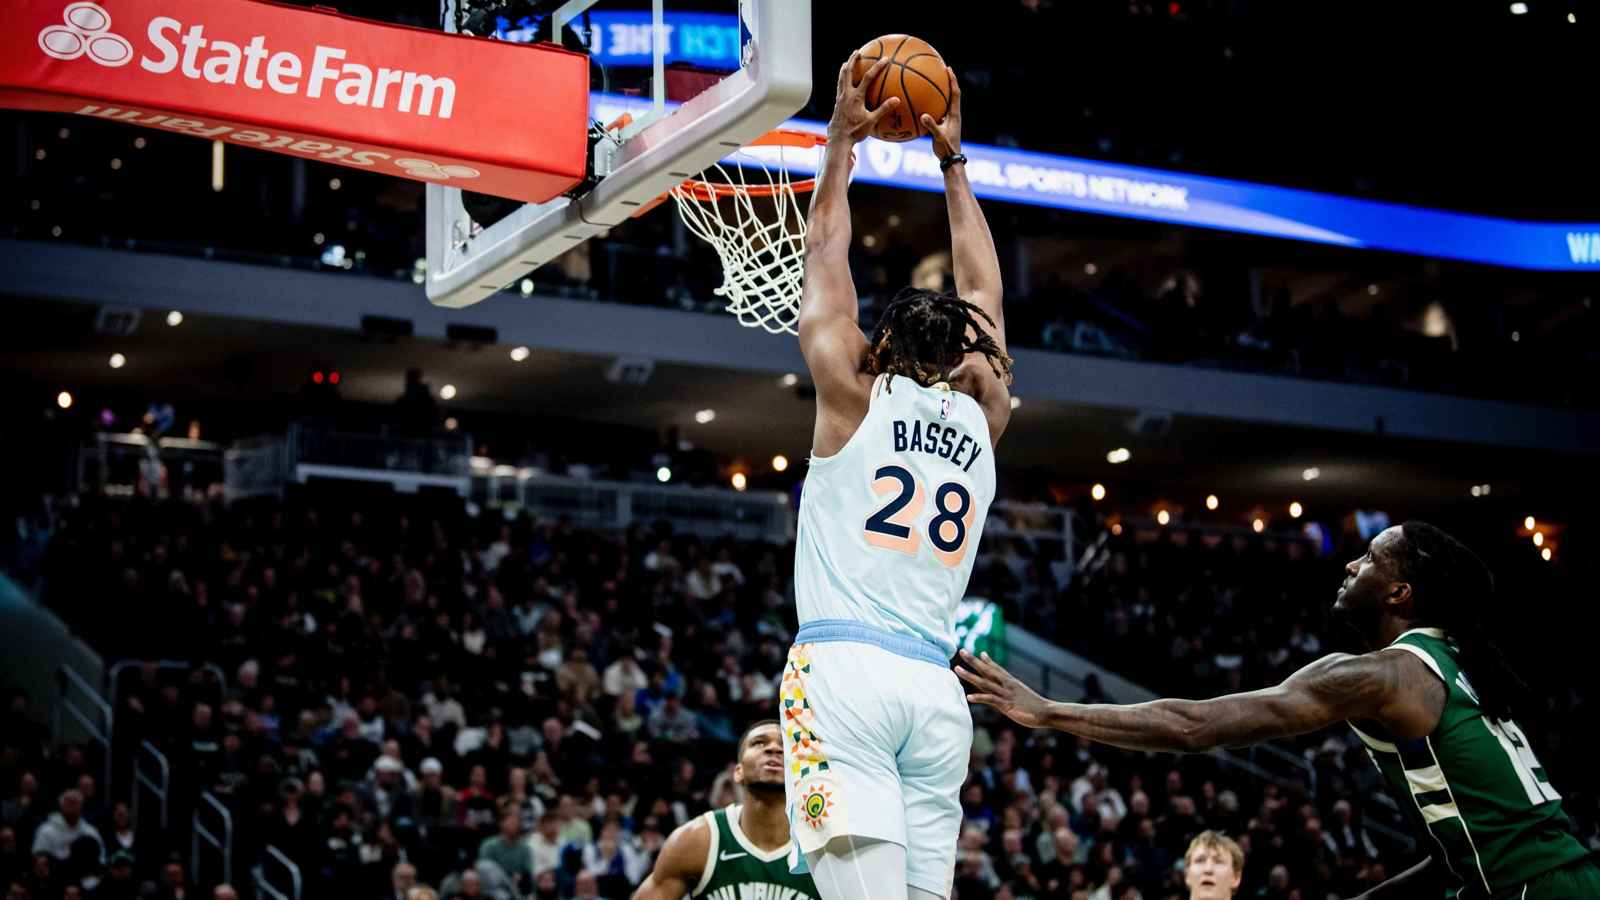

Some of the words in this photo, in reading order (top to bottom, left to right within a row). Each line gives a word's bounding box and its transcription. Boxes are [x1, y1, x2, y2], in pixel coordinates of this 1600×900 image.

[1004, 163, 1087, 198] SPORTS
[1087, 174, 1189, 211] NETWORK
[892, 419, 982, 473] BASSEY
[864, 464, 973, 555] 28
[1480, 717, 1563, 806] 12
